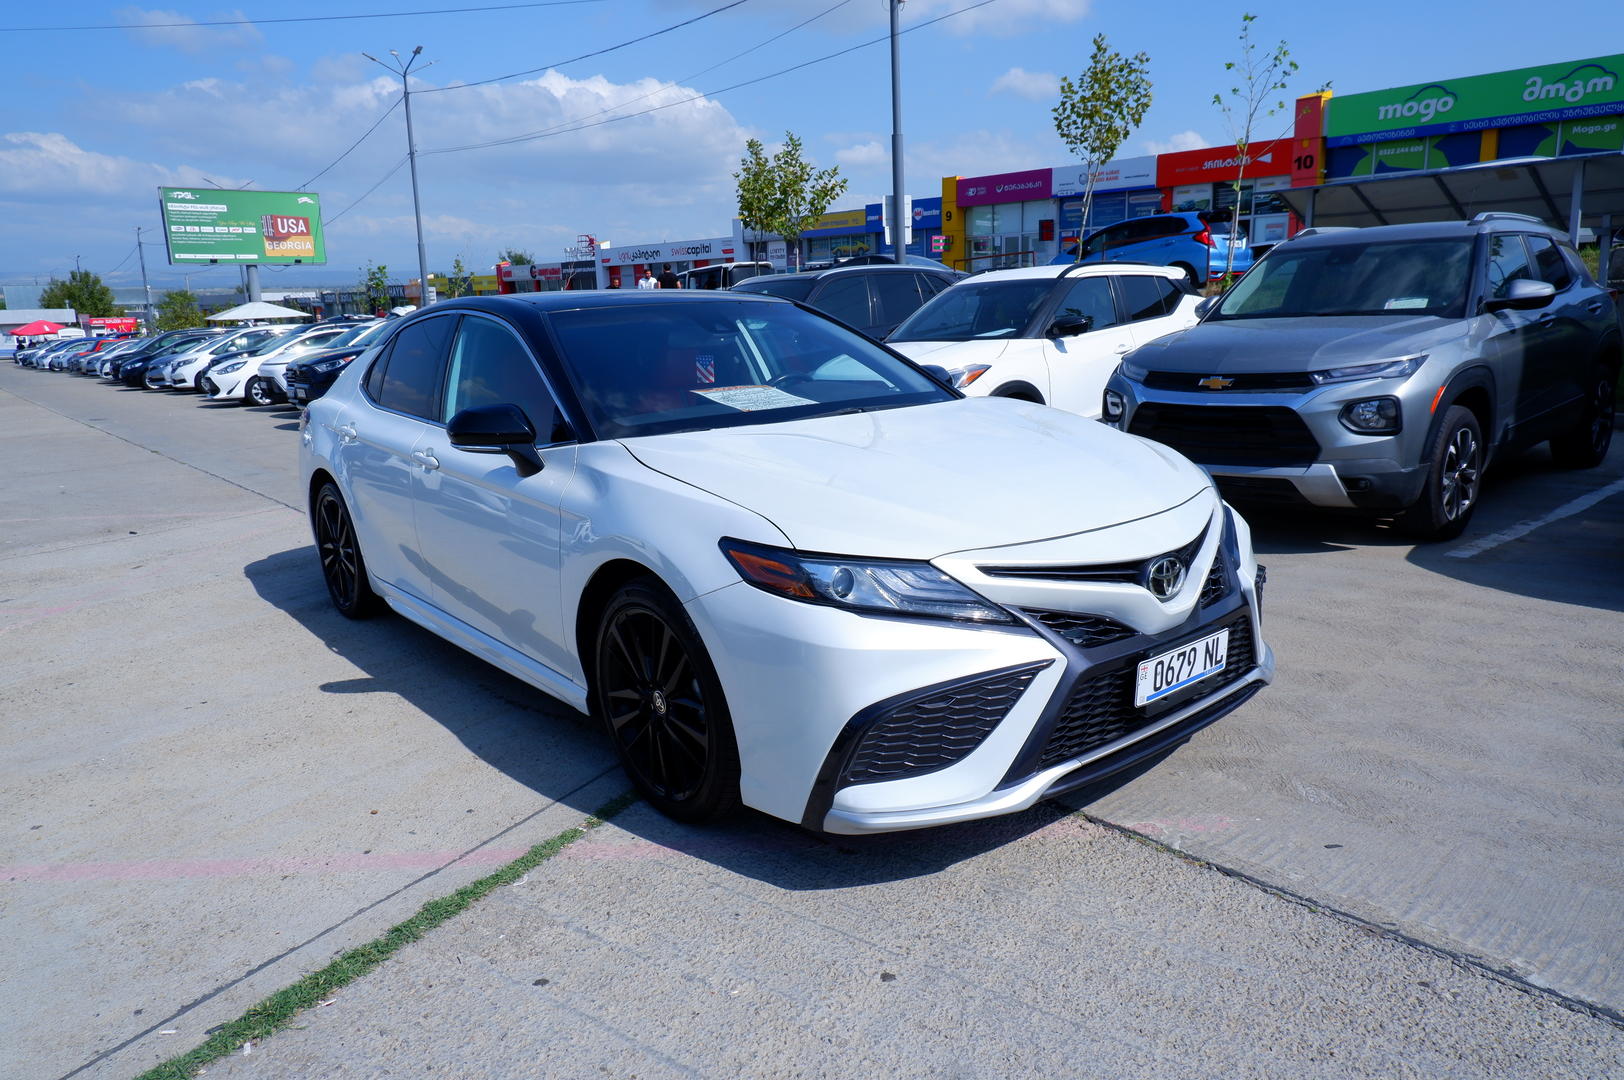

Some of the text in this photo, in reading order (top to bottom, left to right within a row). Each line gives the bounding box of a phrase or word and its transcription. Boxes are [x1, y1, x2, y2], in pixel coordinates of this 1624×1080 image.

[1378, 95, 1455, 123] mogo
[1572, 122, 1617, 135] Mogo.ge
[1294, 155, 1314, 171] 10
[945, 211, 952, 222] 9
[277, 218, 307, 234] USA
[266, 241, 312, 250] GEORGIA
[671, 243, 712, 257] swisscapital
[1153, 636, 1224, 692] 0679 NL
[1139, 672, 1148, 681] GE
